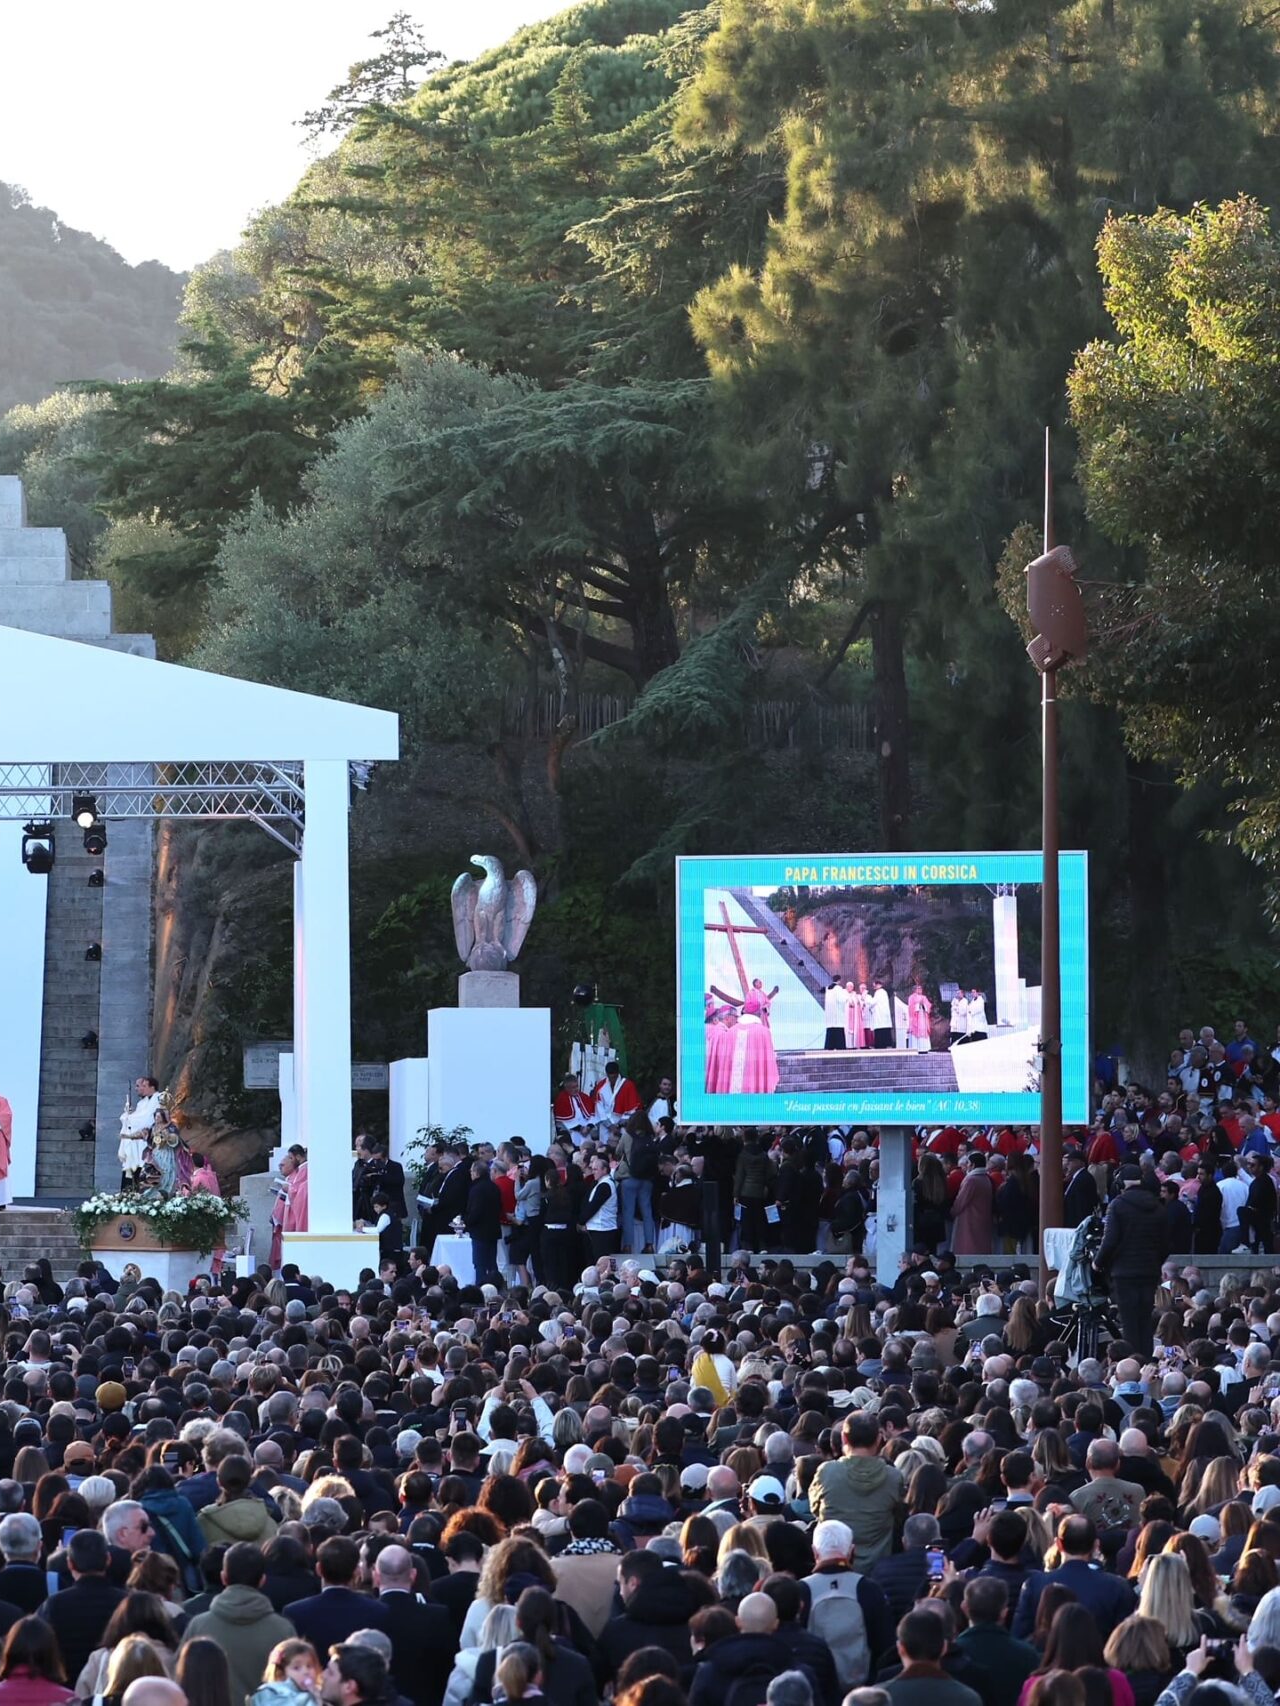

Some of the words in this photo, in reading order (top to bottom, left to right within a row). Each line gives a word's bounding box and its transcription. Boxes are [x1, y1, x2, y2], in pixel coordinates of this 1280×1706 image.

[785, 867, 818, 881] PAPA
[822, 865, 899, 881] FRANCESCU
[903, 865, 918, 879] IN
[922, 864, 977, 880] CORSICA
[812, 1101, 846, 1115] passait
[847, 1103, 858, 1112] en
[858, 1100, 893, 1114] faisant
[895, 1100, 903, 1112] le
